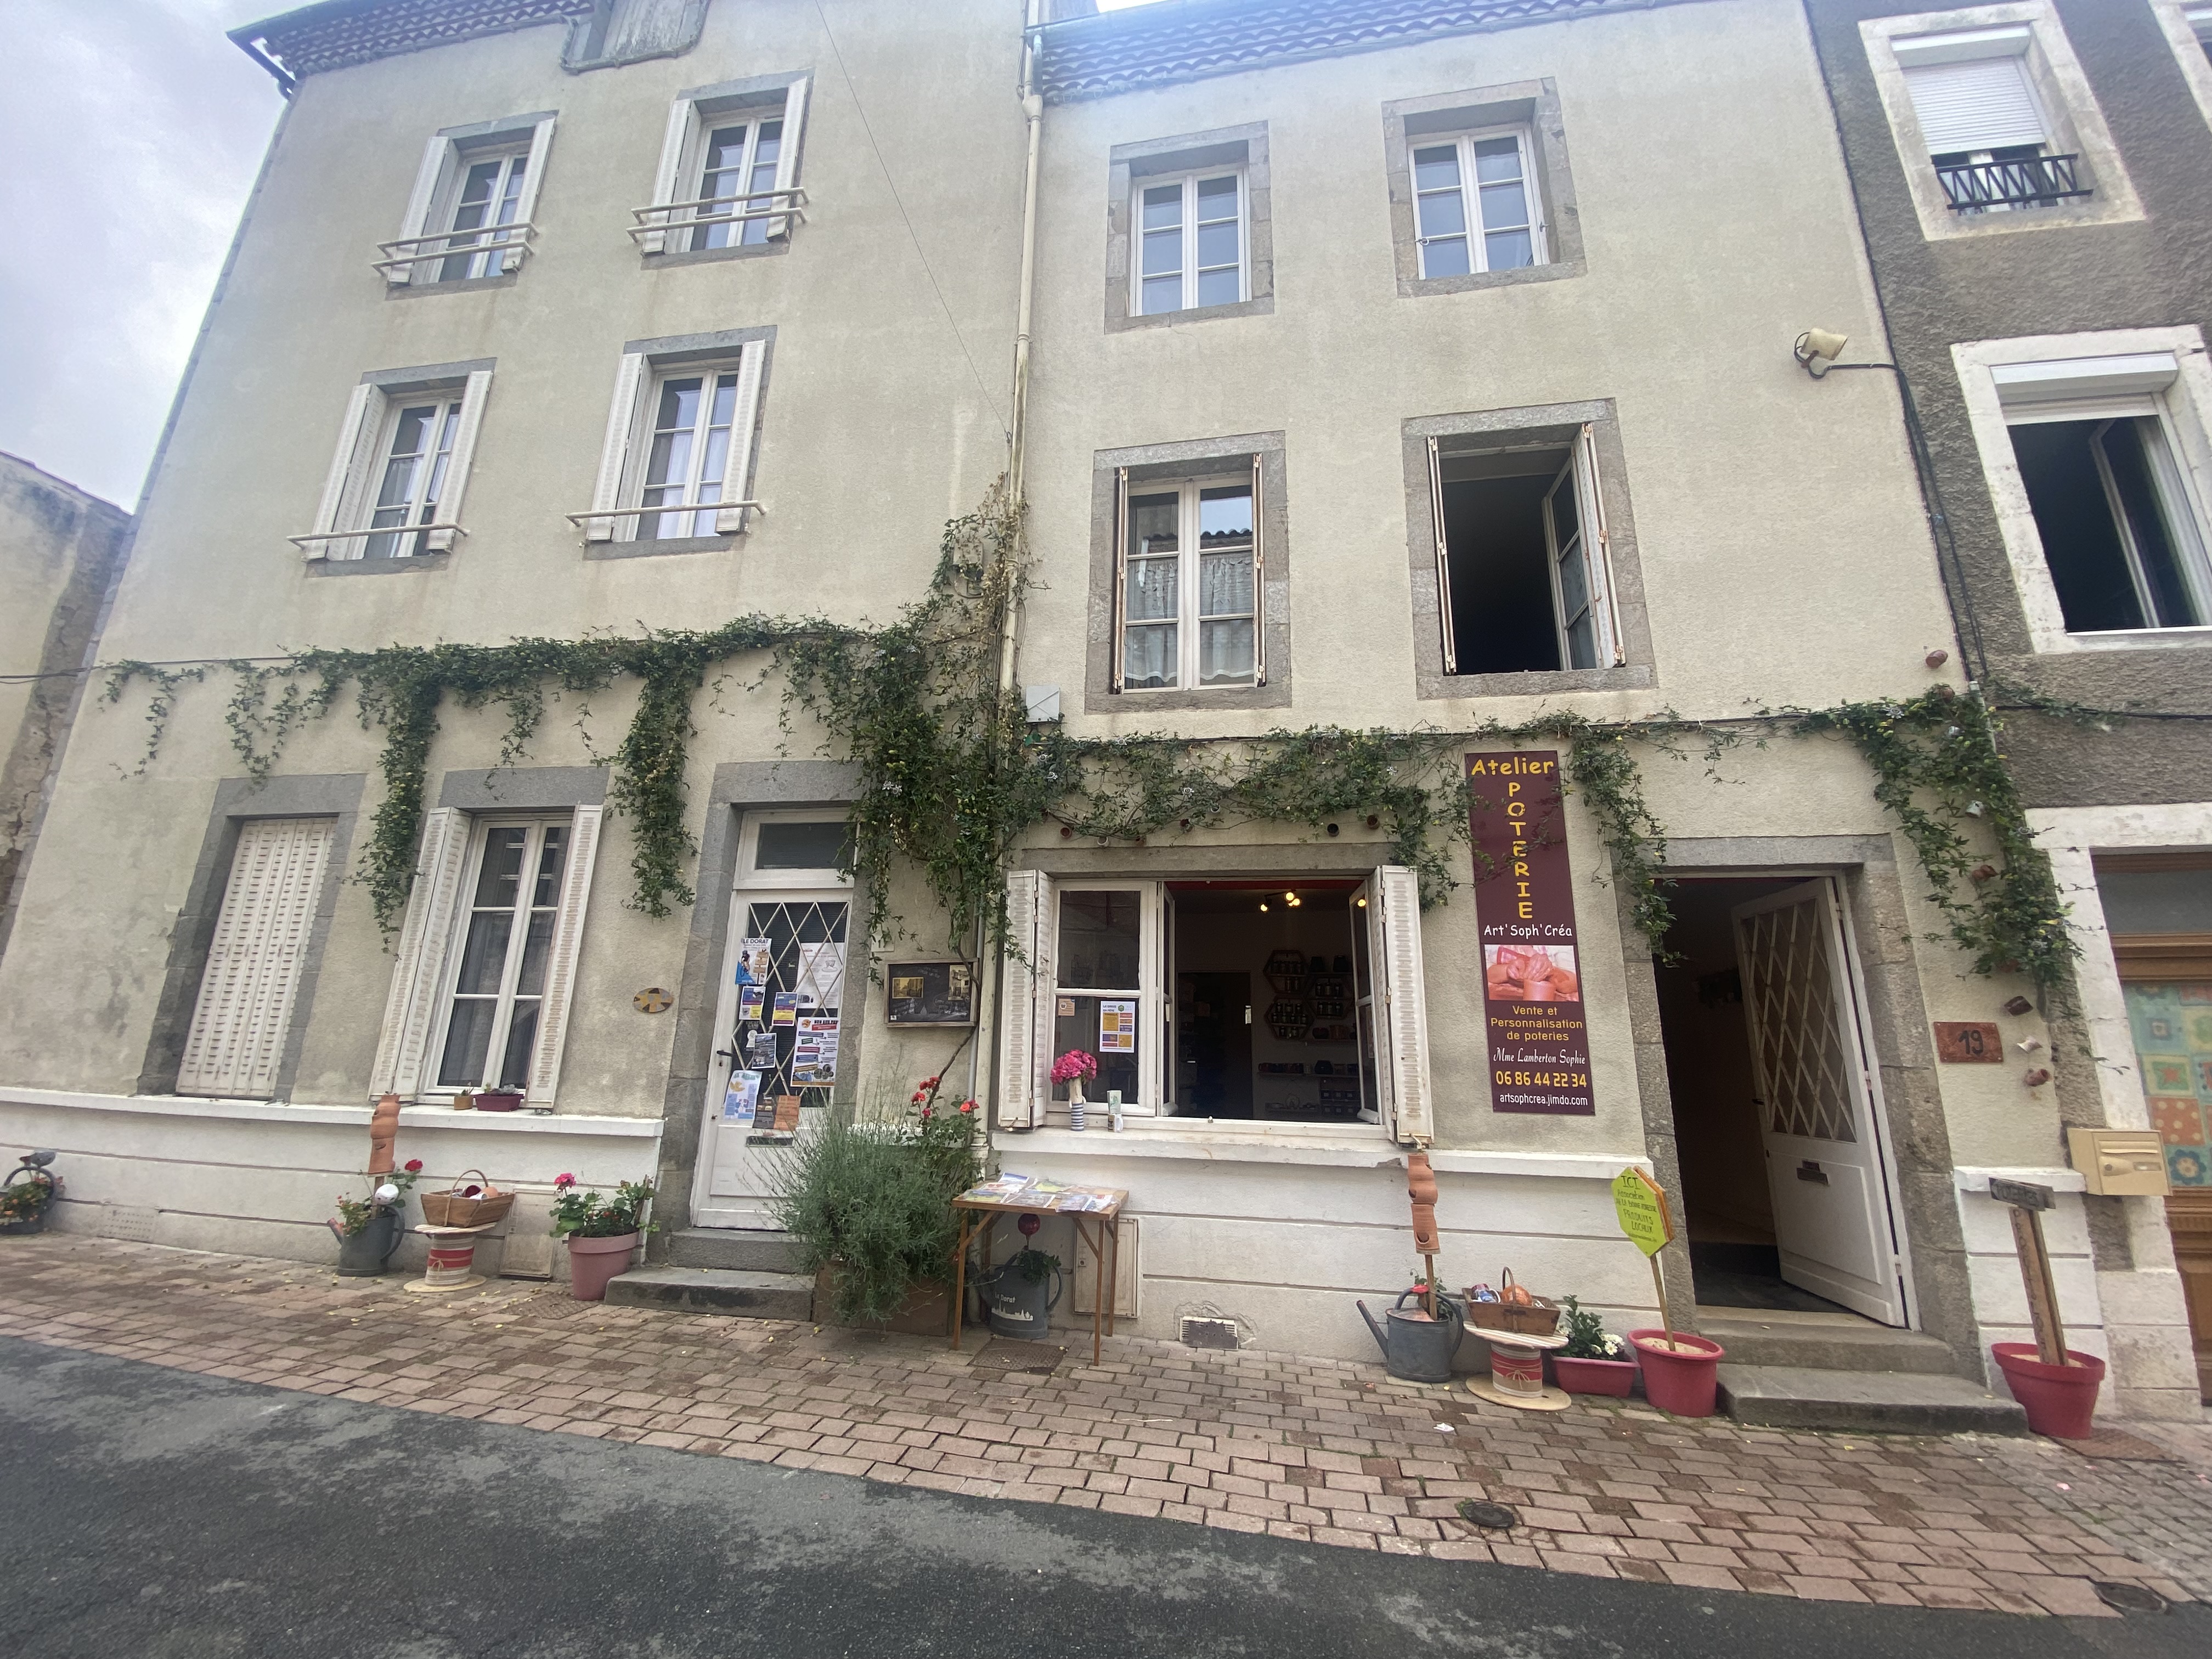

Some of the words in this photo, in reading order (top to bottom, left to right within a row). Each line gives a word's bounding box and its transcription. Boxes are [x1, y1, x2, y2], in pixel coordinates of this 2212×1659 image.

[1471, 757, 1554, 776] Atelier
[1507, 782, 1533, 919] POTERIE
[1513, 1005, 1543, 1015] Vente
[1548, 1007, 1558, 1015] et
[1491, 1018, 1583, 1029] Personnalisation
[1506, 1030, 1520, 1040] de
[1525, 1031, 1570, 1042] poteries
[1957, 1029, 1984, 1057] 19
[1493, 1047, 1515, 1063] Mme
[1517, 1048, 1557, 1064] Lamberton
[1559, 1048, 1585, 1067] Sophie
[1496, 1070, 1512, 1085] 06
[1515, 1071, 1531, 1086] 86
[1534, 1072, 1550, 1086] 44
[1553, 1073, 1569, 1087] 22
[1571, 1073, 1587, 1088] 34
[1499, 1092, 1588, 1107] artsophcrea.jimdo.com
[1621, 1175, 1640, 1190] ICI
[1623, 1208, 1654, 1226] PRODUITS
[1631, 1220, 1653, 1233] LOCAUX
[1000, 1294, 1015, 1303] Dorat
